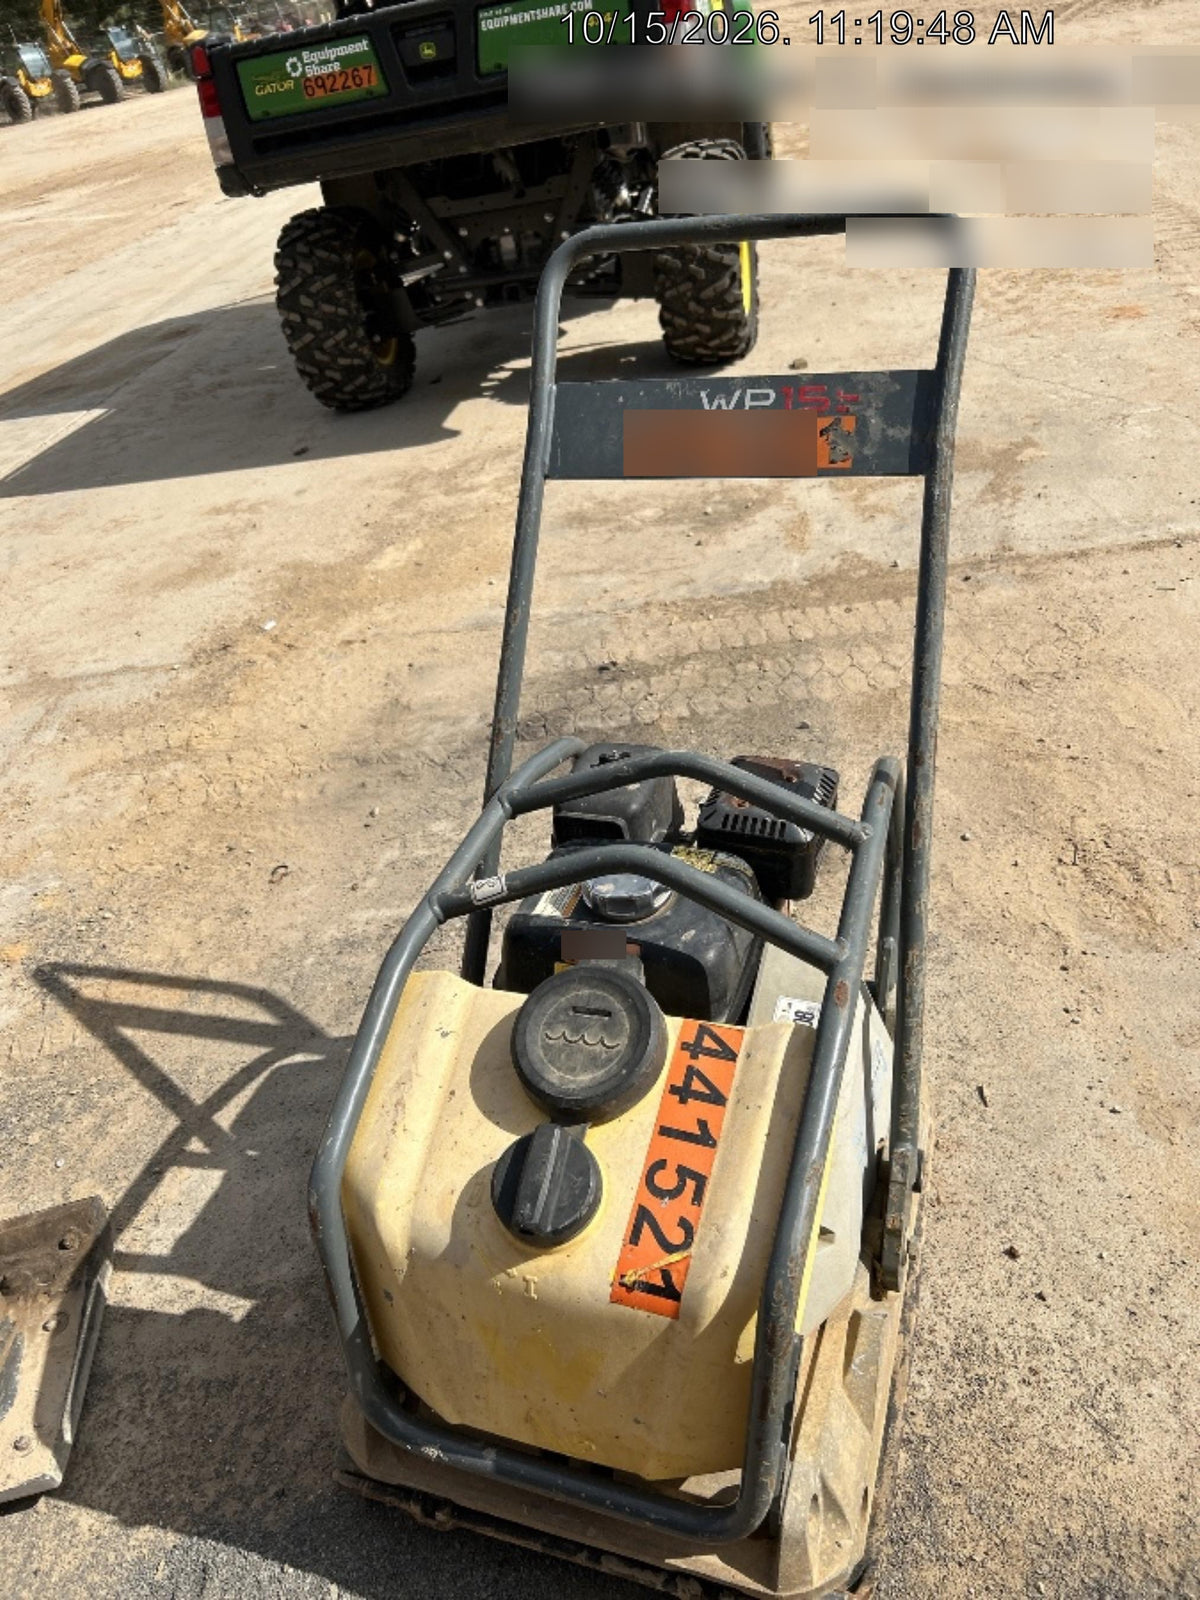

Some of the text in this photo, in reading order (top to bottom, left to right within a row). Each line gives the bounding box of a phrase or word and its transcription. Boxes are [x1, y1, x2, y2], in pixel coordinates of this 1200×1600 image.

[301, 39, 369, 63] Equipment
[303, 65, 374, 97] 692267
[304, 61, 341, 77] Share
[255, 79, 295, 96] GATOR
[617, 1023, 739, 1302] 441521
